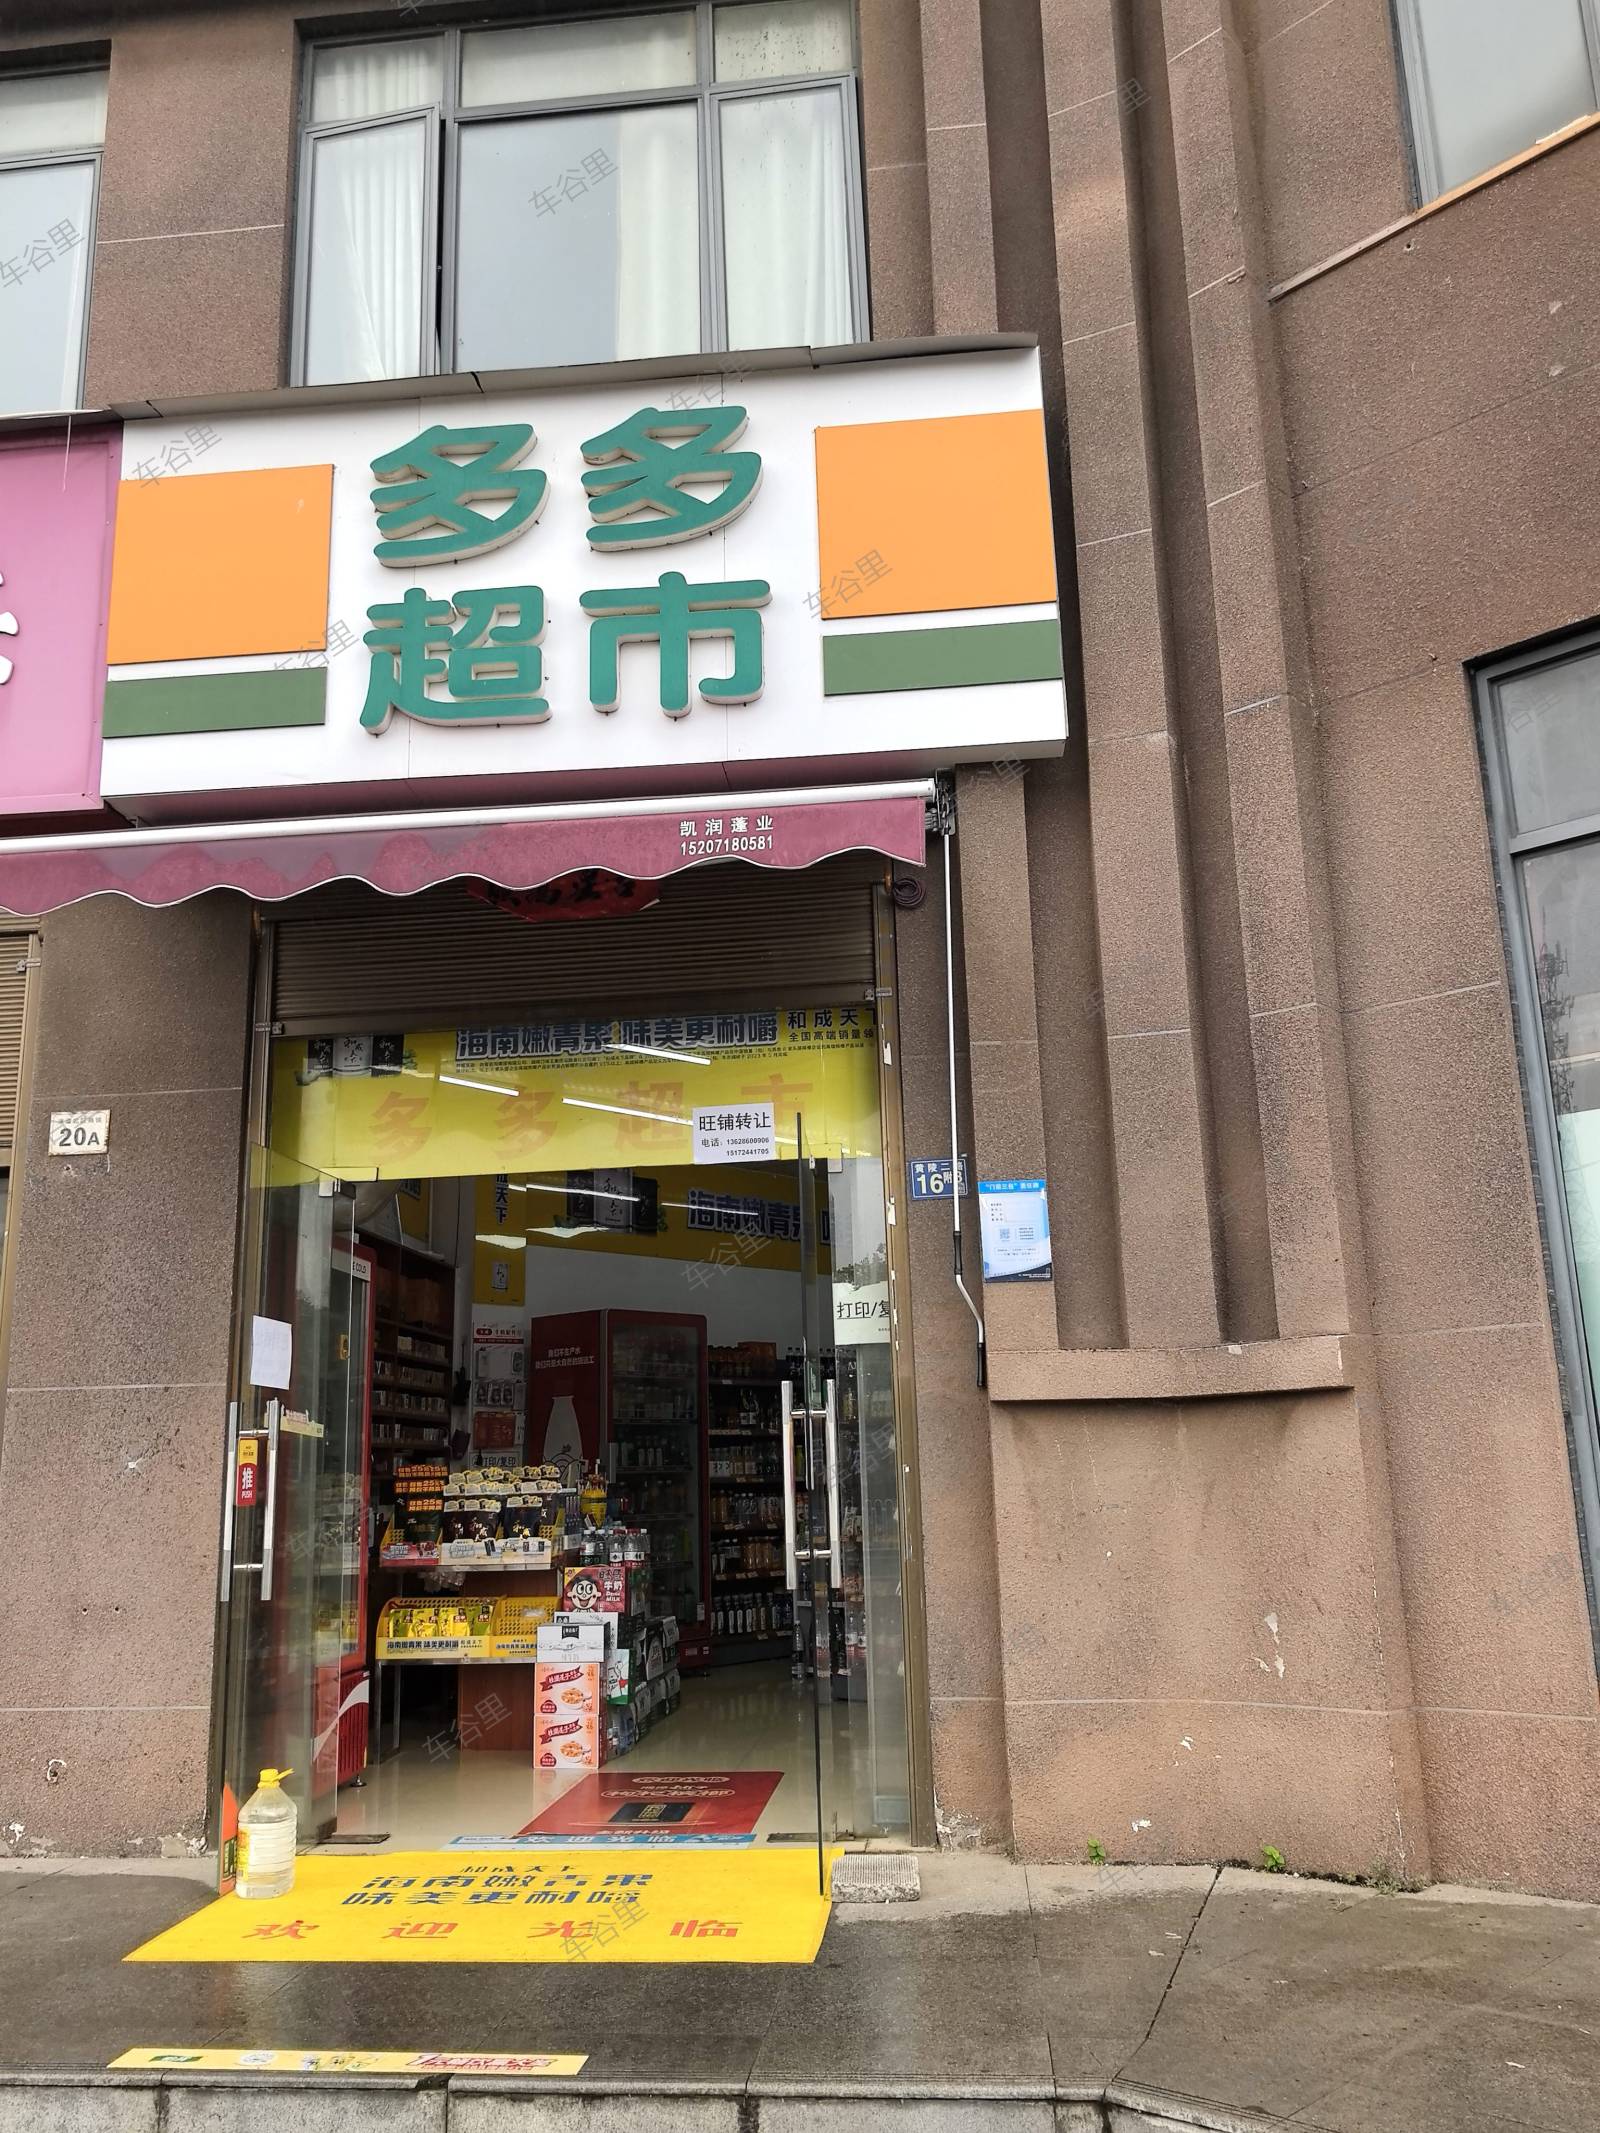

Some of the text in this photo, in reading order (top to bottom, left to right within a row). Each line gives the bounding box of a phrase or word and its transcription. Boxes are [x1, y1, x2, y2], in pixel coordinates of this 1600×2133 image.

[369, 406, 763, 568] 多多
[360, 571, 771, 736] 超市
[680, 815, 774, 837] 凯润蓬业
[681, 835, 773, 856] 15207180581
[699, 1112, 771, 1132] 旺铺转让
[59, 1127, 100, 1147] 20A
[917, 1173, 944, 1194] 16
[242, 1467, 254, 1490] 推
[241, 1919, 743, 1940] 欢迎光临
